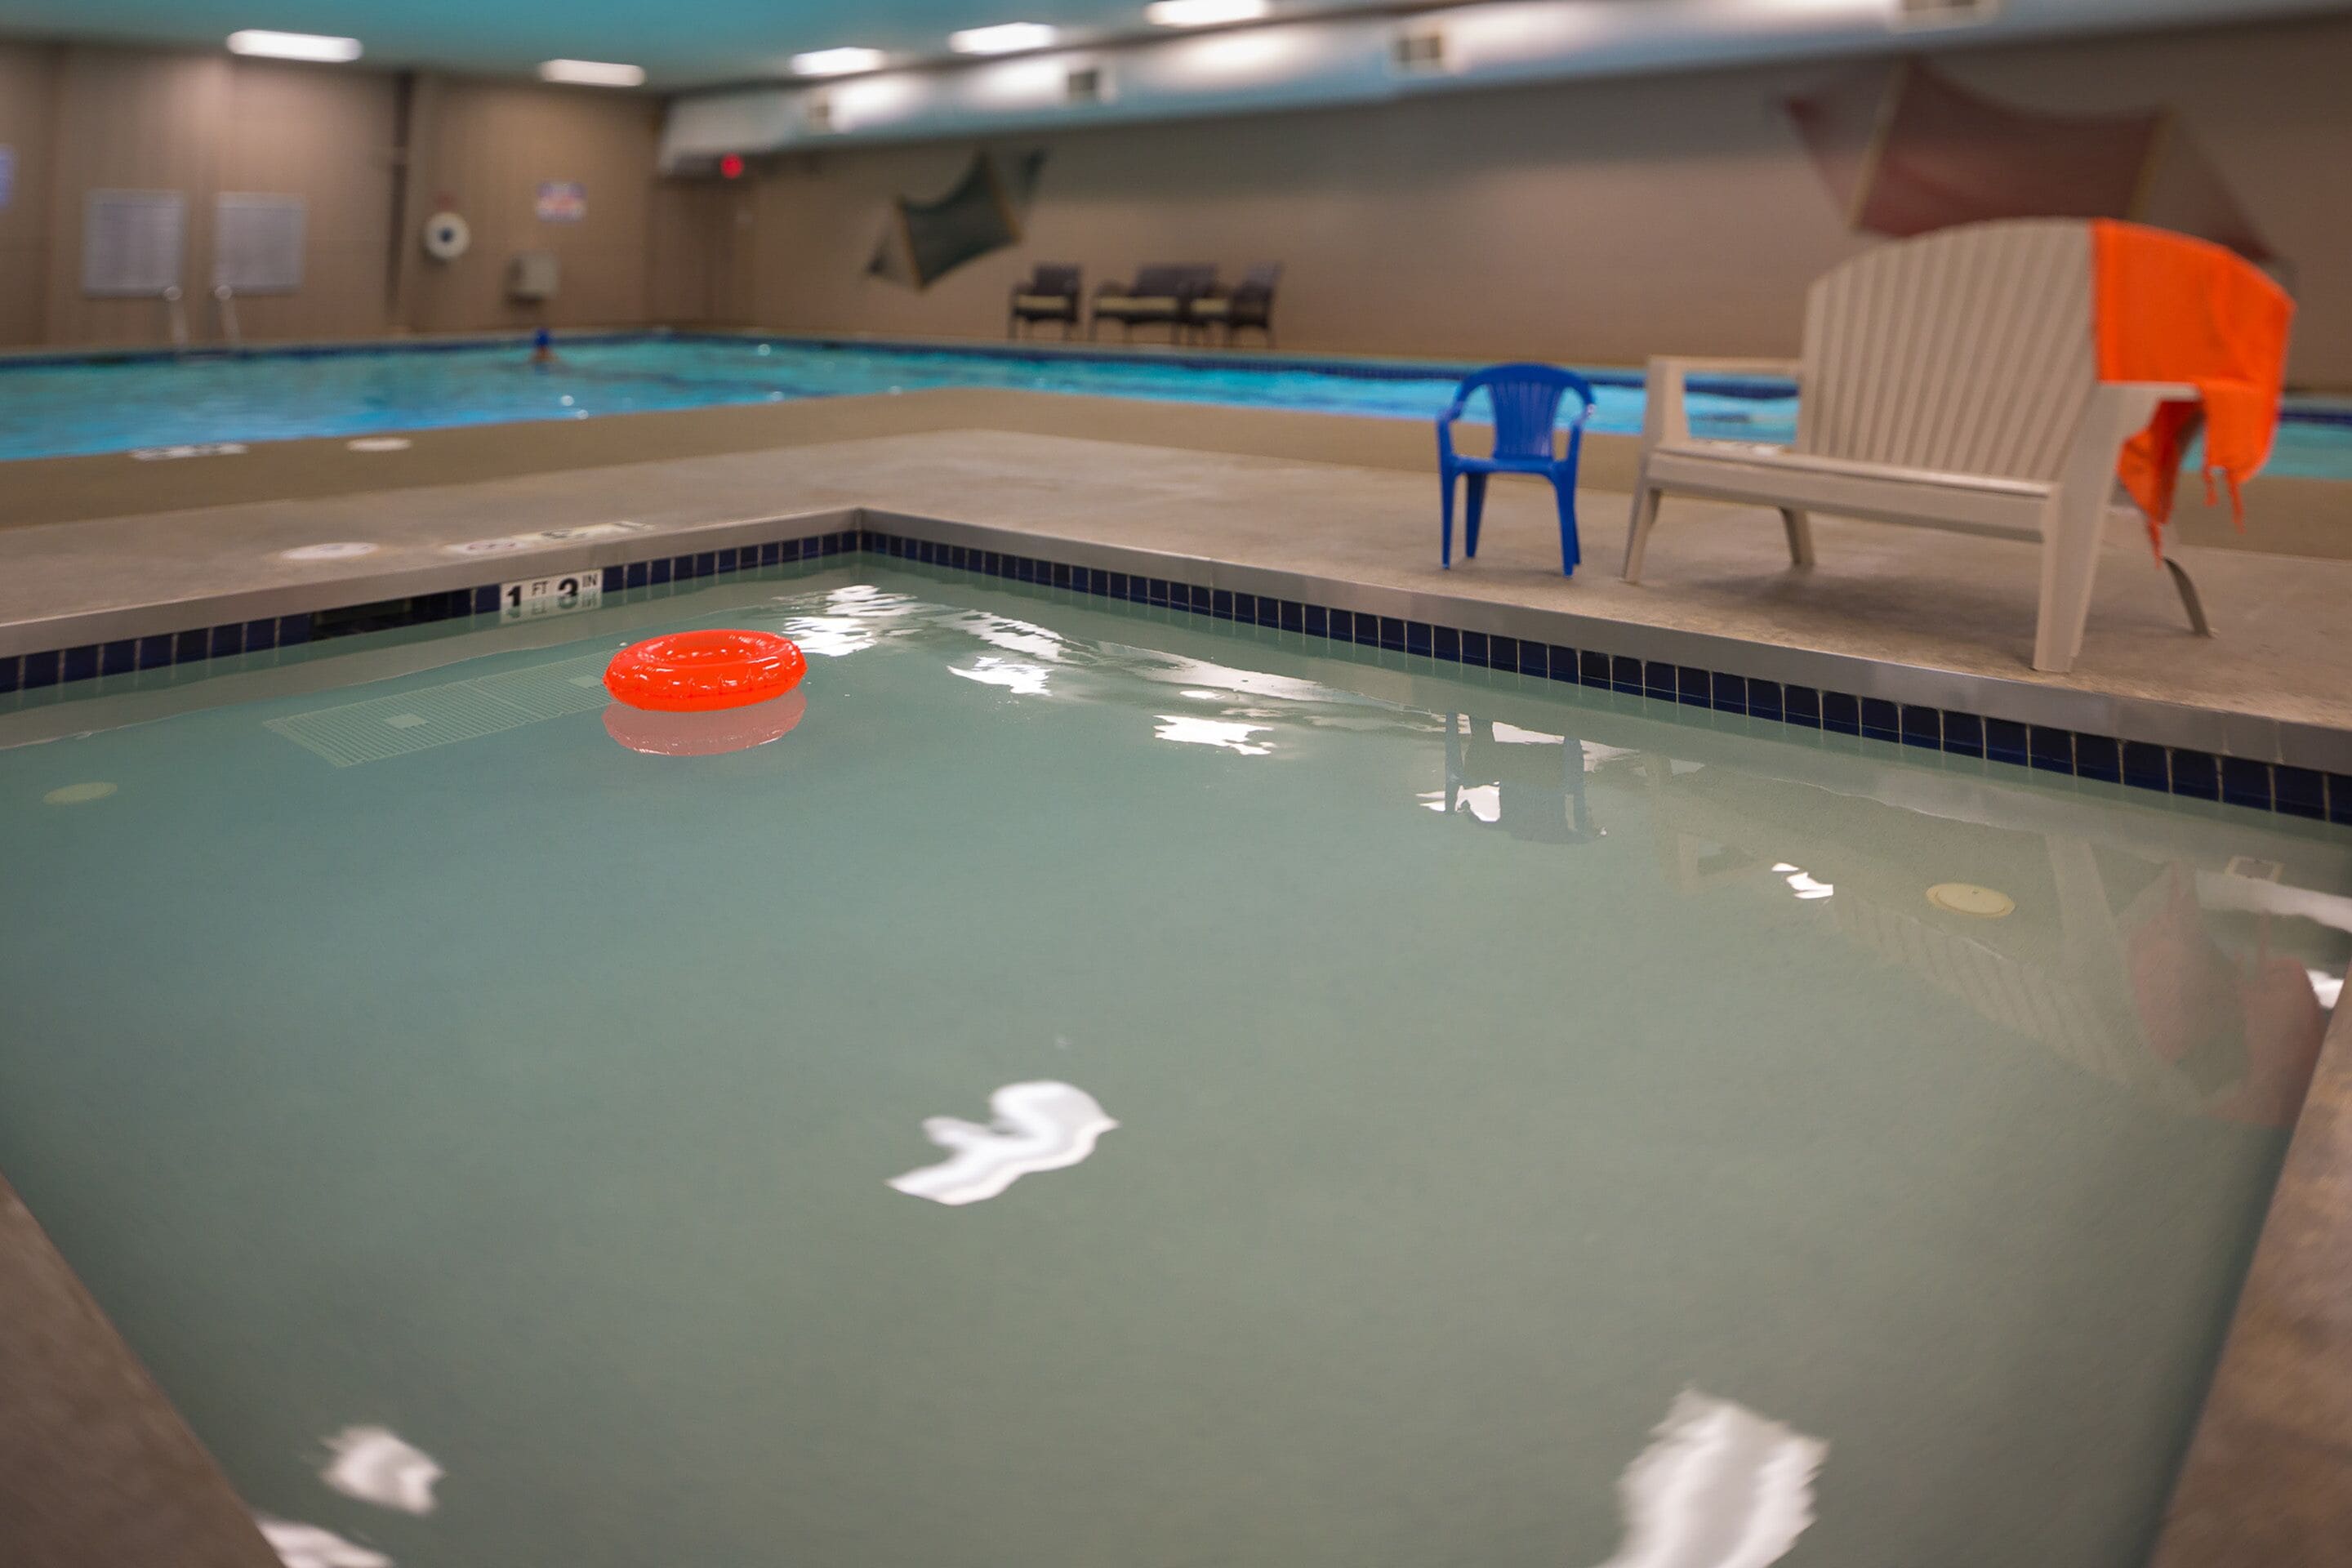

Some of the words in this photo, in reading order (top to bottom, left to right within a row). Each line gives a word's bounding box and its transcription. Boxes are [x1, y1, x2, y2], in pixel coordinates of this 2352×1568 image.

[507, 586, 521, 608] 1
[532, 581, 548, 595] FT
[582, 574, 598, 587] IN
